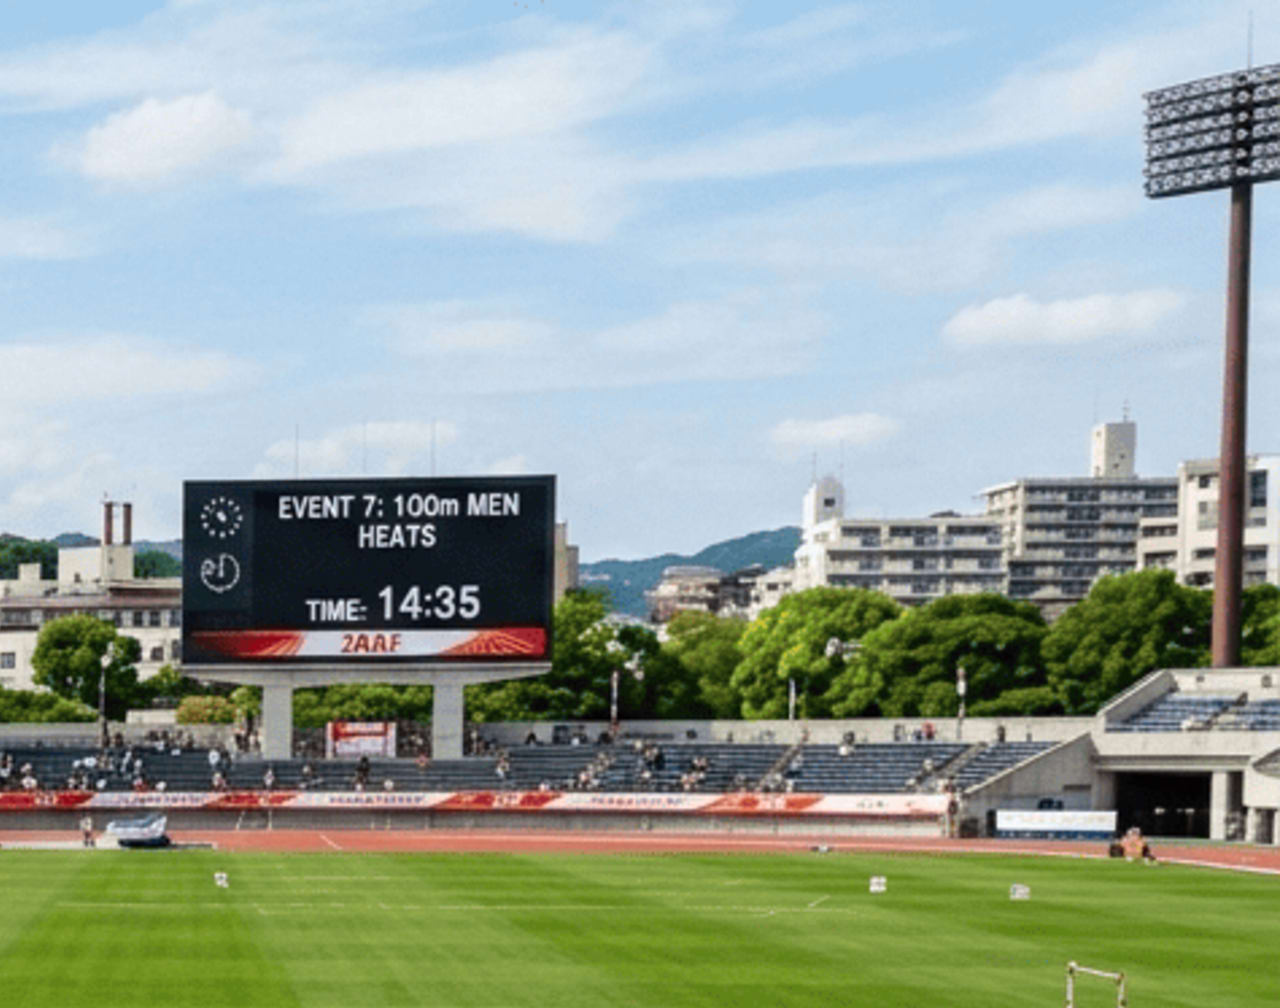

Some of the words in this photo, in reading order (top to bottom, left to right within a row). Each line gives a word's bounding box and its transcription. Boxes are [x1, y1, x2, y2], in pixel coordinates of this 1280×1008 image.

[278, 495, 355, 519] EVENT
[362, 494, 384, 518] 7:
[393, 493, 459, 518] 100m
[467, 492, 520, 517] MEN
[358, 523, 437, 549] HEATS
[305, 599, 367, 622] TIME:
[378, 584, 481, 620] 14:35
